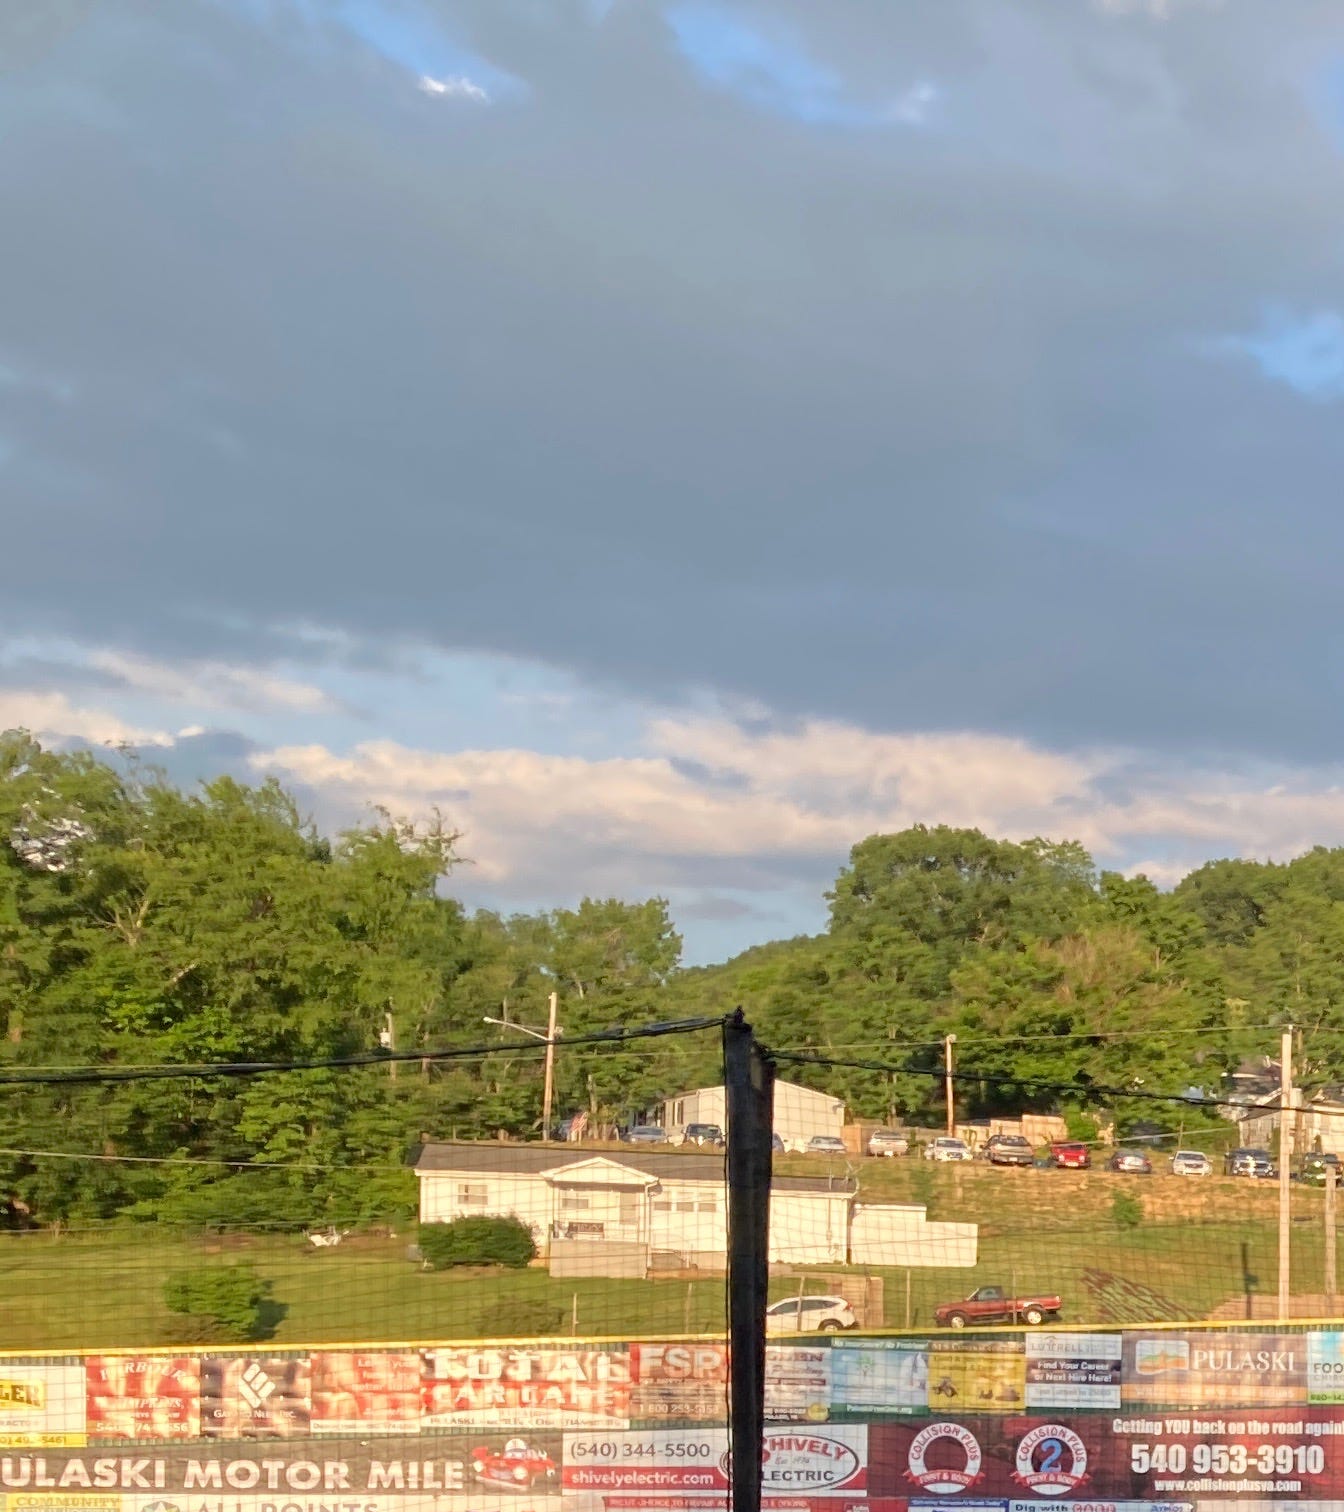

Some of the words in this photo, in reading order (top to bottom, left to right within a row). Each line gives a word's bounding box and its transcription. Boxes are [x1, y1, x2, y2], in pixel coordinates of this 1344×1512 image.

[425, 1348, 630, 1381] TOTAL
[1038, 1362, 1057, 1370] Find
[1060, 1362, 1079, 1370] Your
[1080, 1362, 1109, 1371] Career
[1193, 1350, 1295, 1371] PULASKI
[1045, 1373, 1066, 1381] Next
[1069, 1373, 1087, 1382] Hire
[432, 1384, 506, 1405] CAR
[1112, 1419, 1162, 1435] Getting
[1164, 1420, 1190, 1434] YOU
[1193, 1420, 1226, 1434] back
[1229, 1422, 1247, 1434] on
[1248, 1420, 1269, 1434] the
[1272, 1420, 1303, 1434] road
[570, 1443, 618, 1459] (540)
[624, 1443, 711, 1458] 344-5500
[912, 1426, 961, 1460] COLLISION
[960, 1434, 979, 1461] PLUS
[1019, 1427, 1067, 1462] COLLISION
[1067, 1436, 1086, 1463] PLUS
[1040, 1440, 1062, 1473] 2
[1131, 1444, 1186, 1474] 540
[1193, 1444, 1325, 1474] 953-3910
[1, 1457, 166, 1488] ULASKI
[183, 1459, 351, 1489] MOTOR
[367, 1460, 464, 1489] MILE
[572, 1468, 714, 1486] shivelyelectric.com
[762, 1470, 834, 1481] LECTRIC
[1154, 1479, 1302, 1492] www.collisionplusva.com
[16, 1497, 120, 1506] COMMUNITY
[1015, 1504, 1036, 1512] Dig
[1040, 1504, 1069, 1512] with
